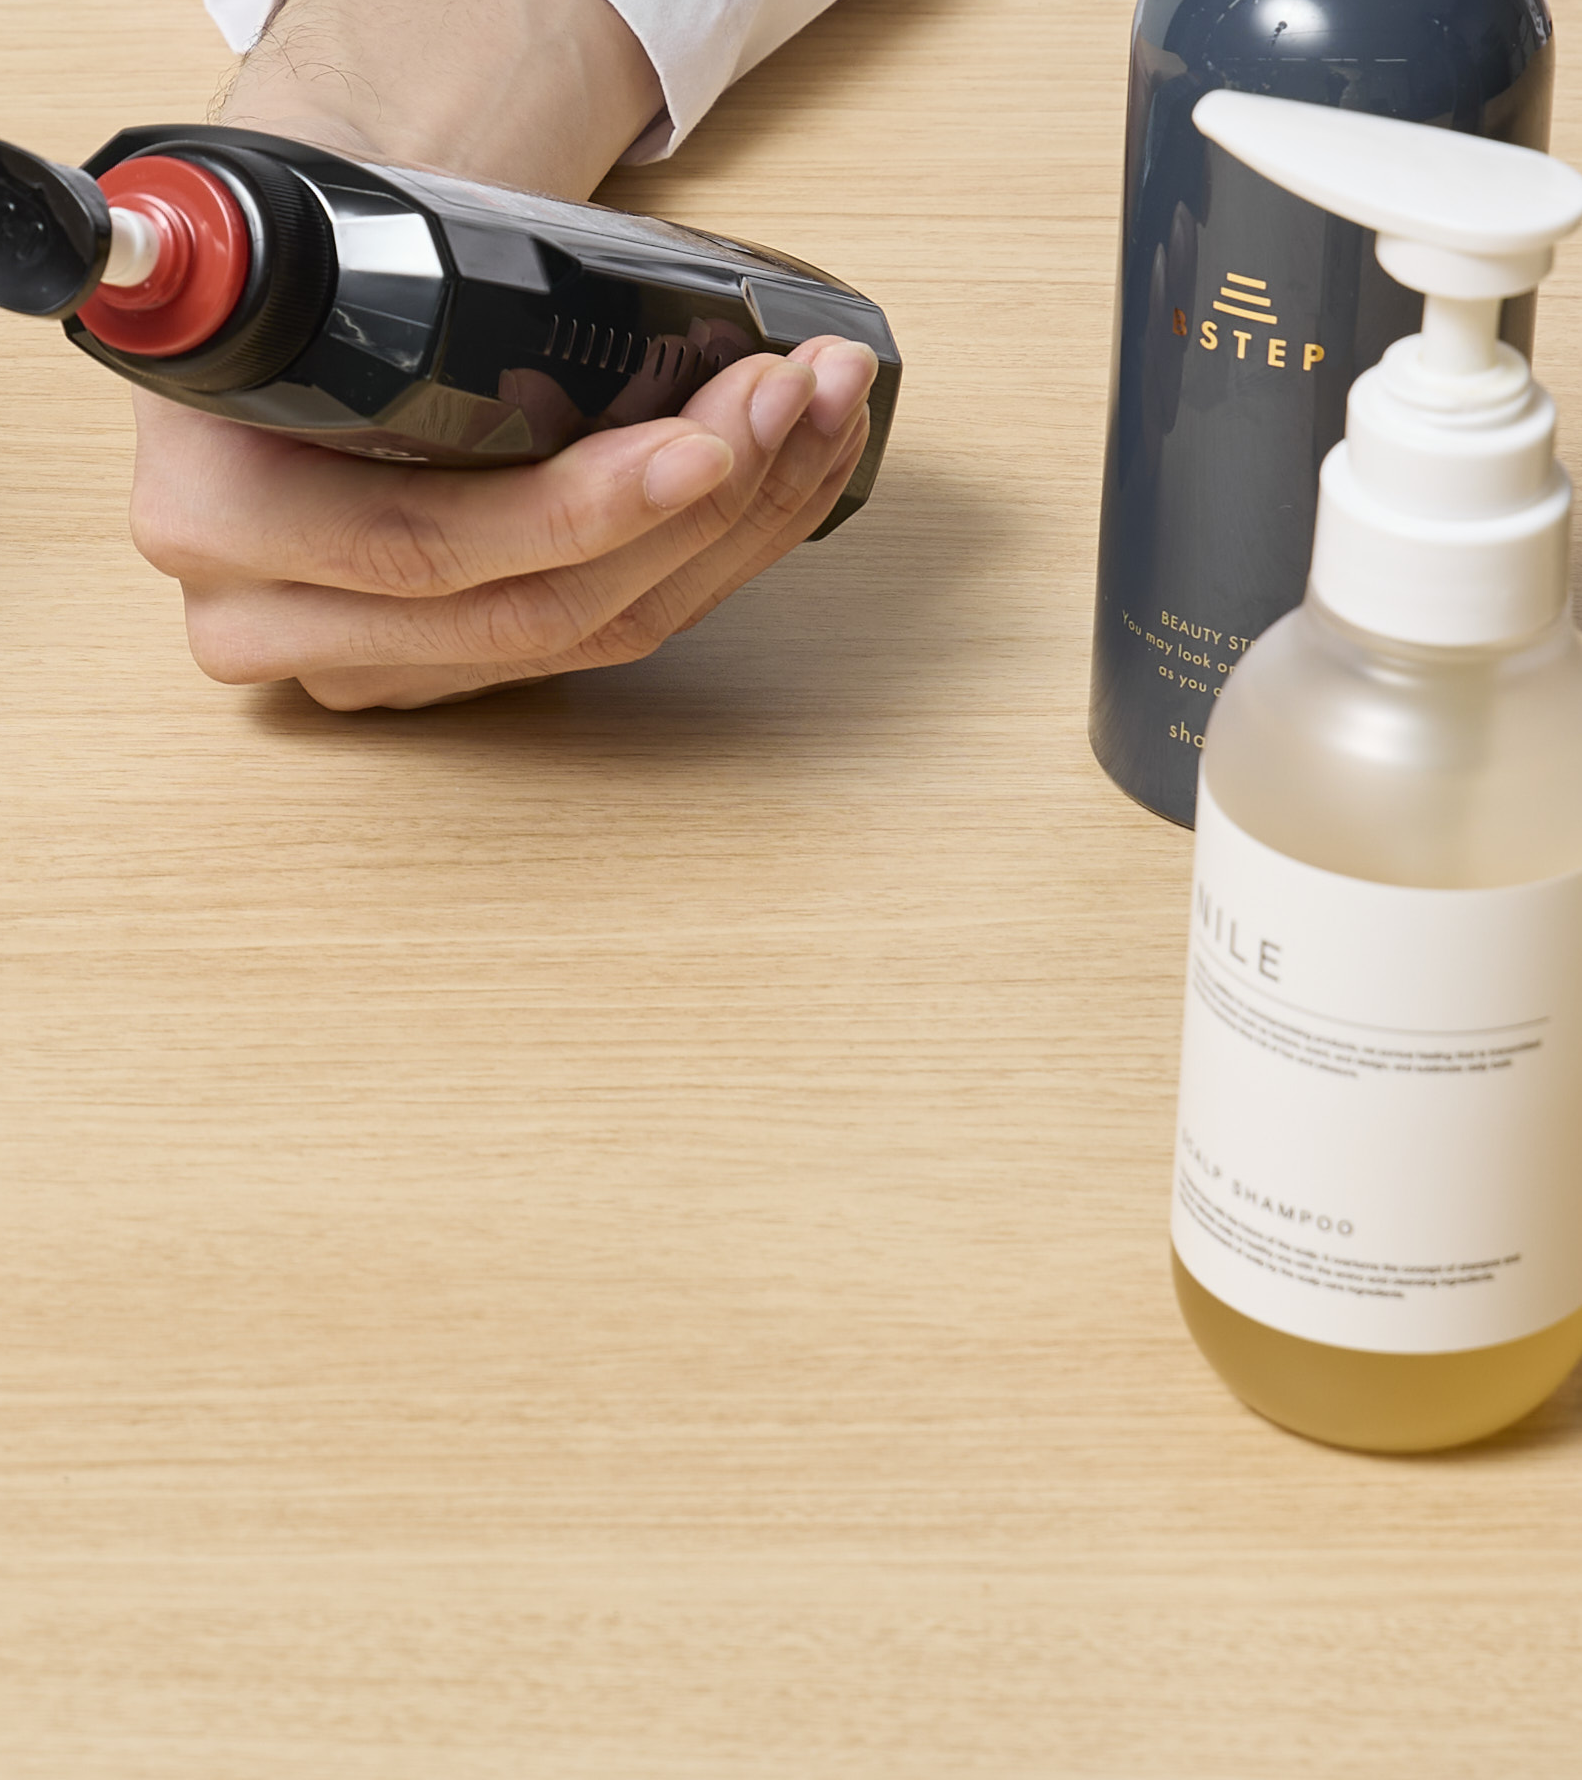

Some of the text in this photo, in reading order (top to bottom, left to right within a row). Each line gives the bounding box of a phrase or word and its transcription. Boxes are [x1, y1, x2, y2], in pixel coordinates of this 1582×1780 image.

[1122, 609, 1142, 636] You
[1145, 631, 1173, 656] may
[1178, 644, 1211, 669] look
[1161, 611, 1222, 645] BEAUTY
[1158, 665, 1174, 680] as
[1179, 674, 1207, 693] you
[1231, 1179, 1355, 1238] SHAMPOO
